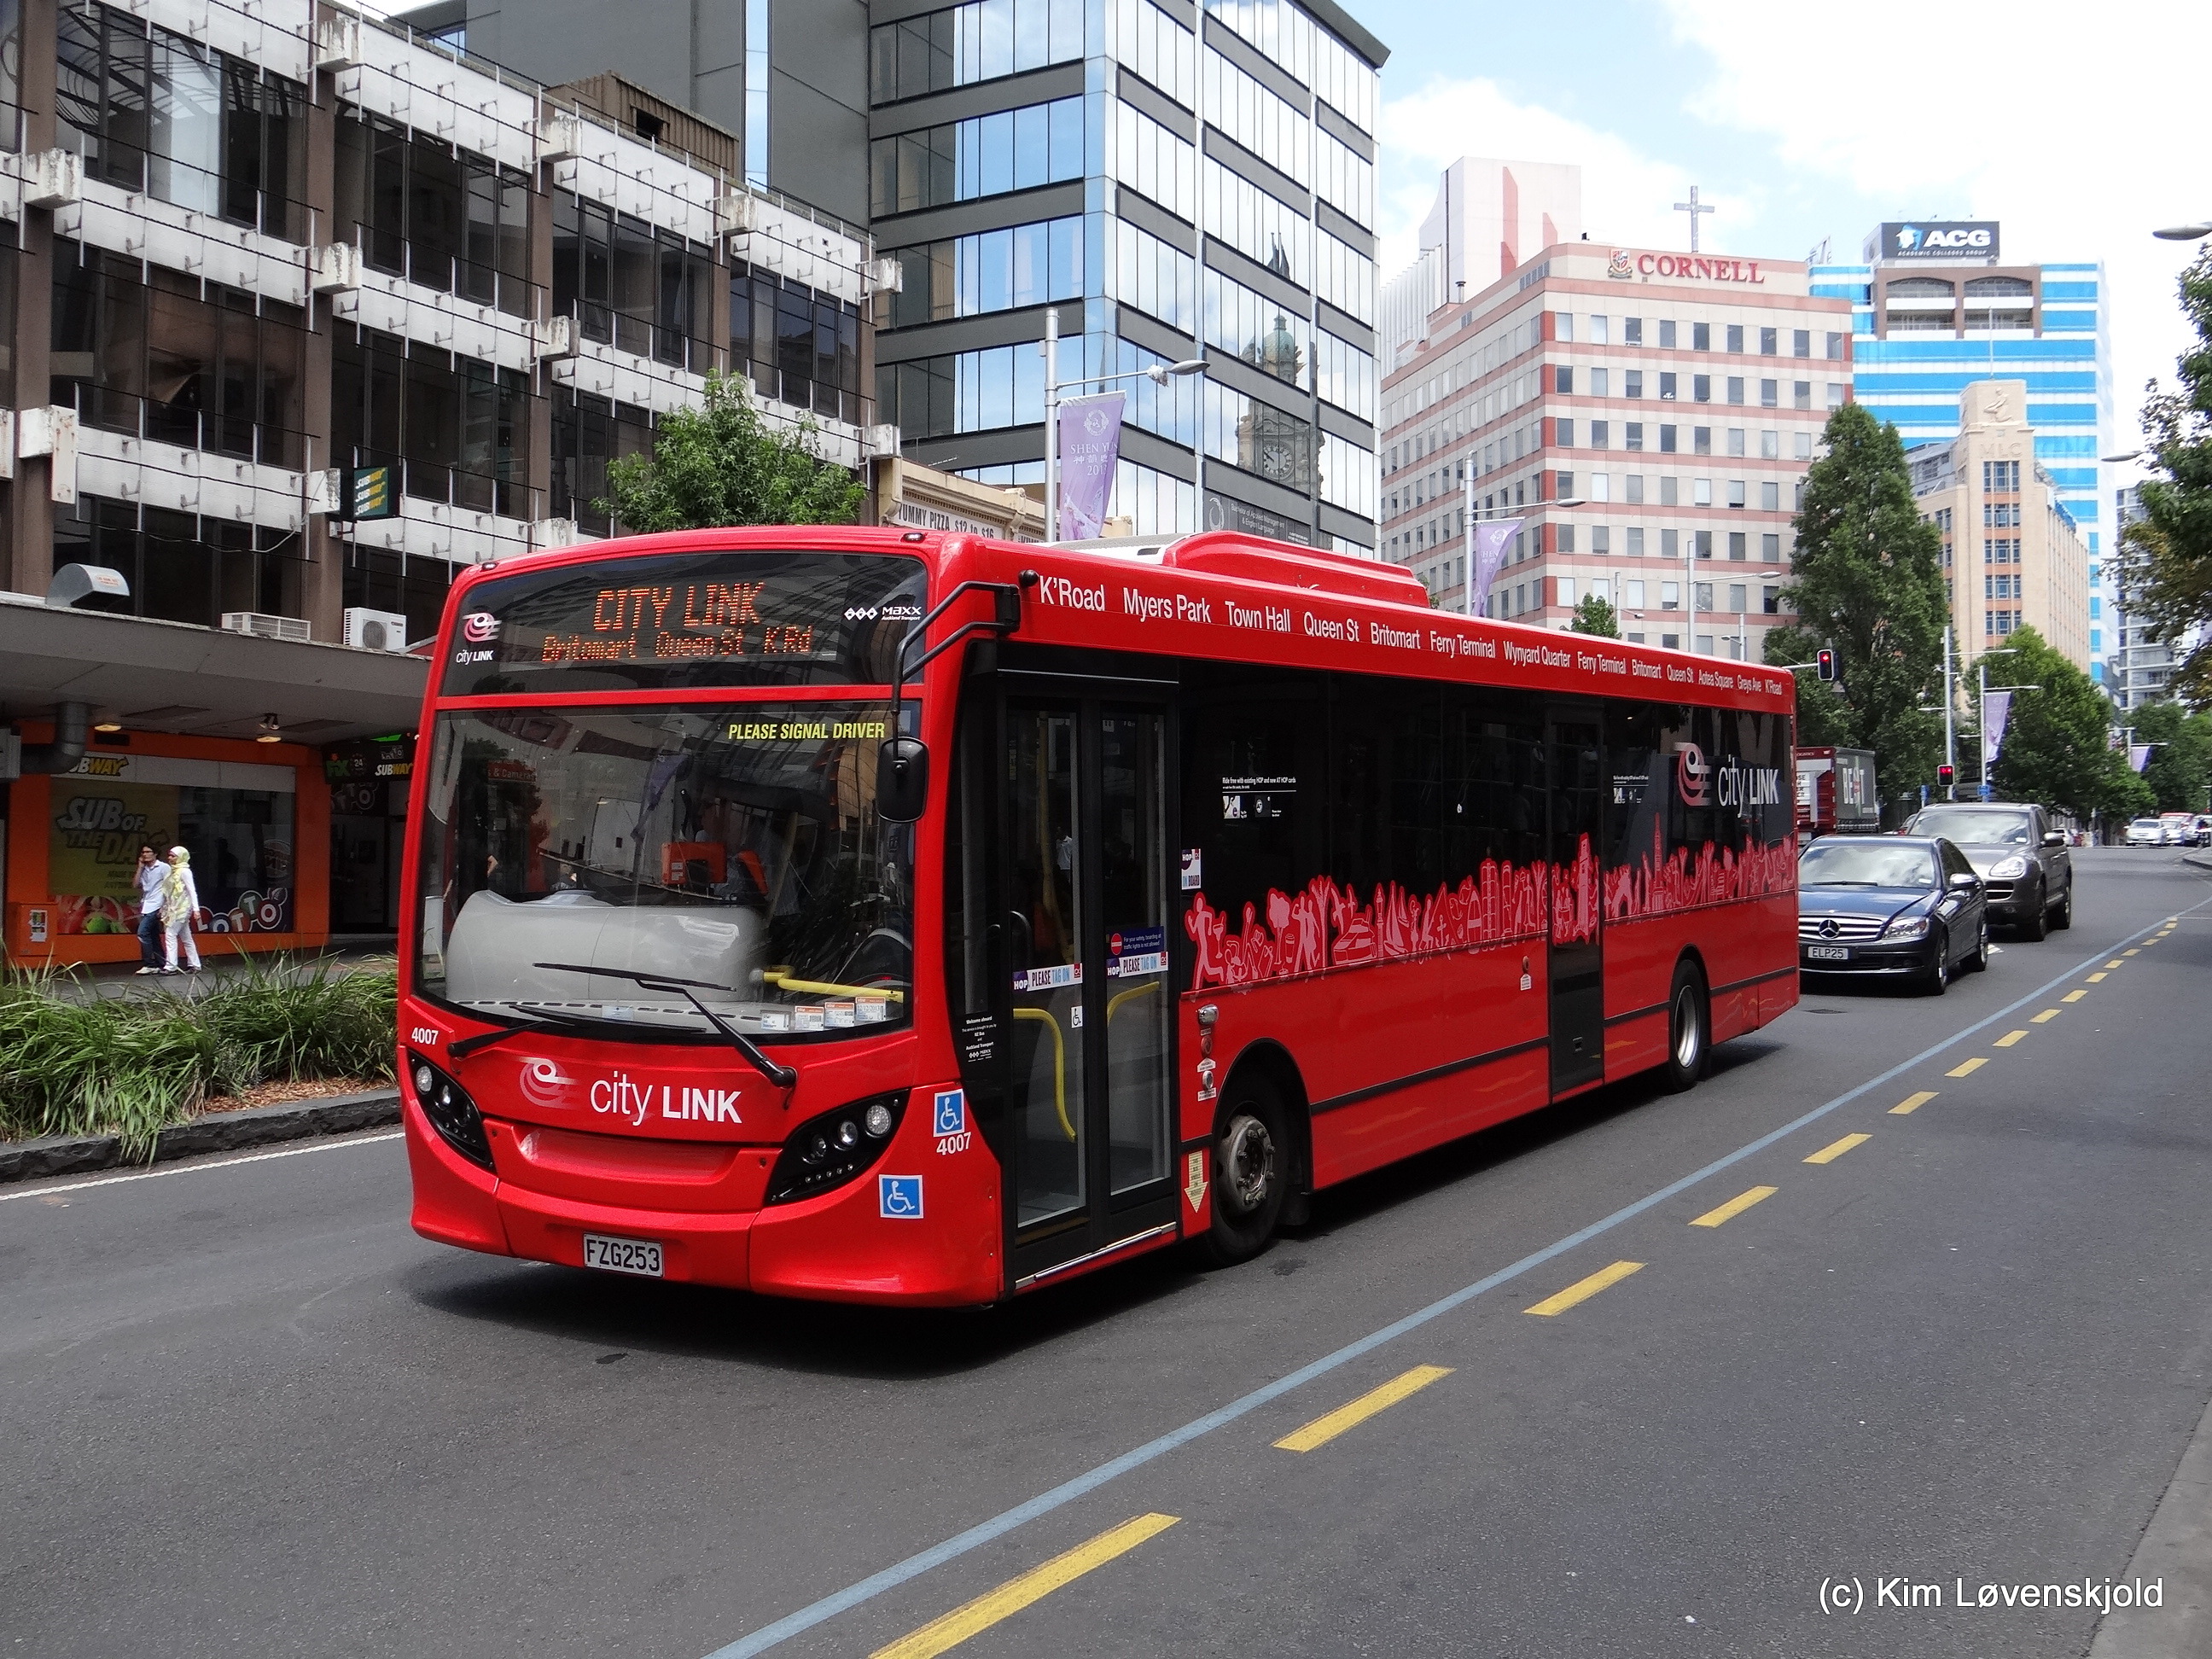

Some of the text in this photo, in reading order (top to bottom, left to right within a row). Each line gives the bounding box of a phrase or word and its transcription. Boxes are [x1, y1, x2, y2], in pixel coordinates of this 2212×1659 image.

[1923, 230, 1990, 247] ACG
[1638, 254, 1765, 284] CORNELL
[1070, 443, 1101, 454] SHEN
[1981, 442, 2023, 459] MLC
[355, 468, 386, 489] SUBWAY
[355, 481, 386, 503] SUBWAY
[355, 495, 385, 515] SUBWAY
[899, 504, 994, 539] YUMMY PIZZA $12 to $16
[593, 581, 766, 632] CITY LINK
[541, 625, 812, 663] Britomart Queen St K Rd
[1039, 574, 1105, 612] K'Road
[1122, 587, 1173, 622] Myers
[1176, 594, 1212, 624] Park
[1225, 600, 1263, 630] Town
[1266, 605, 1291, 633] Hall
[1303, 611, 1344, 640] Queen
[1346, 619, 1359, 643] St
[1371, 621, 1421, 650] Britomart
[1429, 630, 1457, 659] Ferry
[1457, 633, 1496, 659] Terminal
[1503, 640, 1541, 667] Wynyard
[1541, 645, 1571, 668] Quarter
[1577, 651, 1597, 675] Ferry
[1597, 654, 1627, 675] Terminal
[1632, 658, 1662, 679] Britomart
[1667, 664, 1686, 683] Queen
[1685, 667, 1694, 684] St
[1714, 671, 1734, 690] Square
[1737, 674, 1753, 694] Greys
[1752, 677, 1762, 693] Ave
[456, 649, 494, 666] city LINK
[728, 721, 886, 741] PLEASE SIGNAL DRIVER
[69, 756, 129, 777] BWAY
[354, 759, 364, 767] 24
[375, 762, 413, 777] SUBWAY
[502, 768, 534, 781] Cameras
[1718, 754, 1747, 818] city
[1749, 769, 1779, 805] LINK
[1842, 767, 1866, 805] BET
[56, 798, 147, 831] SUB OF
[67, 830, 103, 848] THE
[196, 894, 276, 933] LOTTO
[1812, 948, 1844, 959] ELP25
[1123, 958, 1140, 975] PLEASE
[1140, 956, 1150, 971] TAG
[1150, 955, 1157, 969] ON
[1032, 969, 1051, 987] PLEASE
[1051, 969, 1062, 984] TAG
[1062, 967, 1070, 982] ON
[411, 1027, 439, 1045] 4007
[590, 1071, 742, 1126] city LINK
[936, 1132, 971, 1155] 4007
[586, 1238, 661, 1272] FZG253
